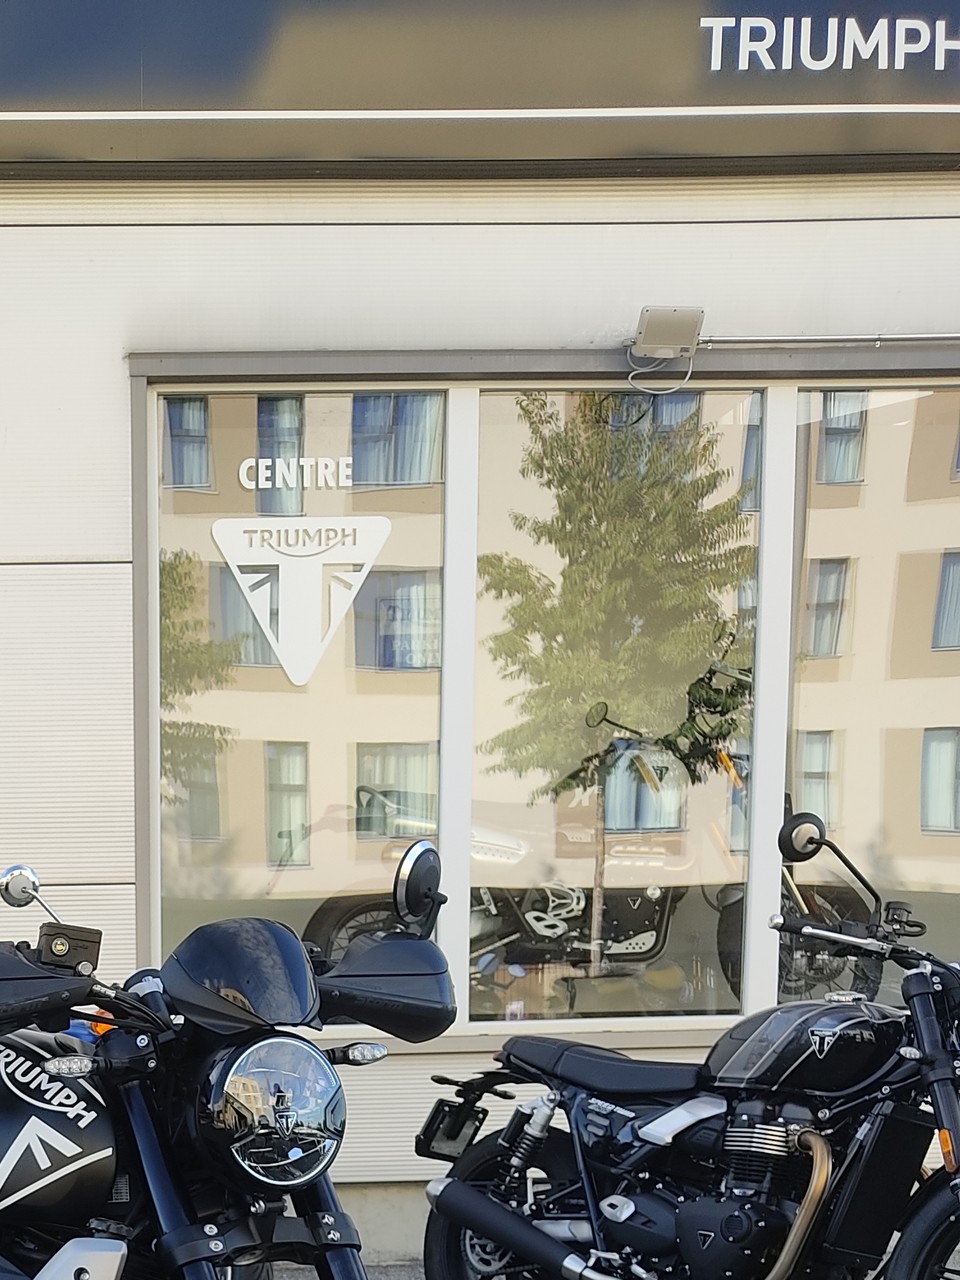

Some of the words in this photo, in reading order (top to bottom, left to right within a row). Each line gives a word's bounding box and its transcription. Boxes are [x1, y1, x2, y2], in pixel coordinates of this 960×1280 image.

[700, 17, 960, 71] TRIUMPH
[239, 457, 353, 490] CENTRE
[243, 528, 358, 557] TRIUMPH
